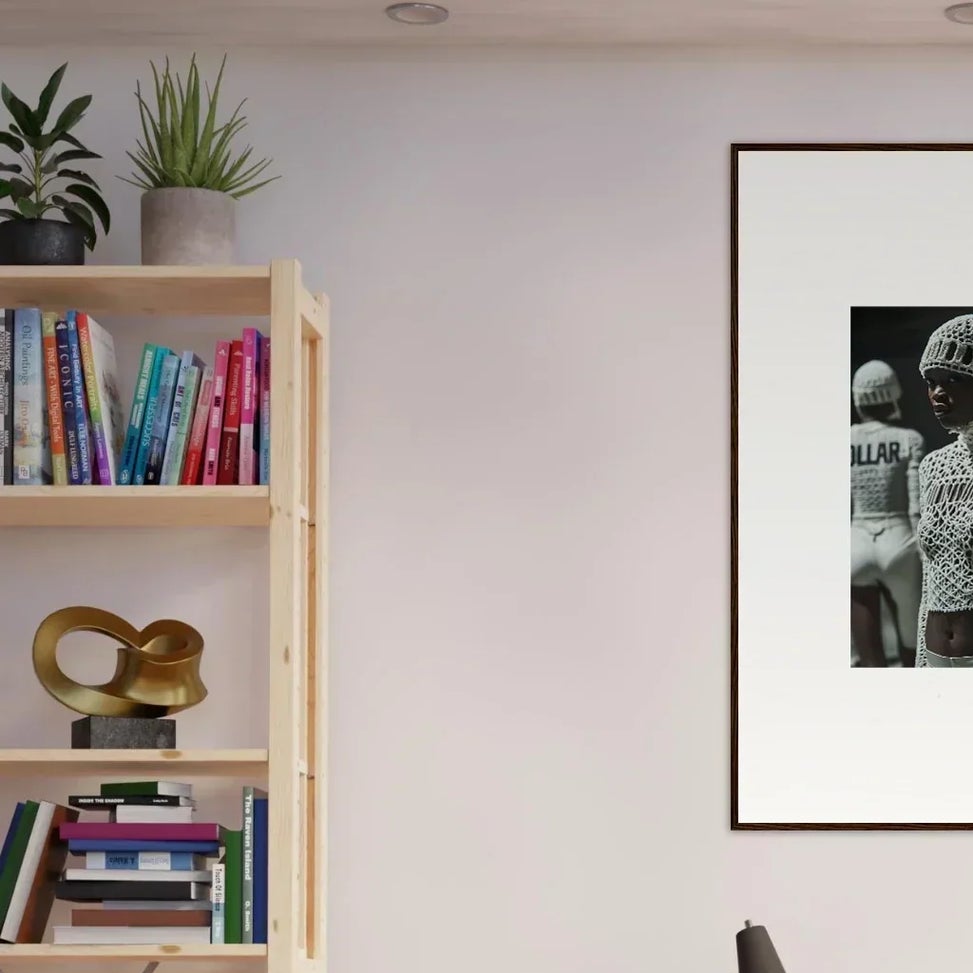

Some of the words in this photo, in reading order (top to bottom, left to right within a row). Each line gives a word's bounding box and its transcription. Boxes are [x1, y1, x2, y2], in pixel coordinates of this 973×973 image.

[22, 325, 31, 339] Oil
[19, 342, 31, 386] Paintings
[46, 347, 54, 363] FINE
[48, 364, 56, 380] ART
[79, 327, 90, 373] Watercolor
[87, 374, 98, 411] Portraits
[231, 363, 240, 396] Parenting
[49, 384, 58, 401] With
[49, 402, 60, 424] Digital
[52, 424, 61, 442] Tools
[244, 850, 252, 881] Island
